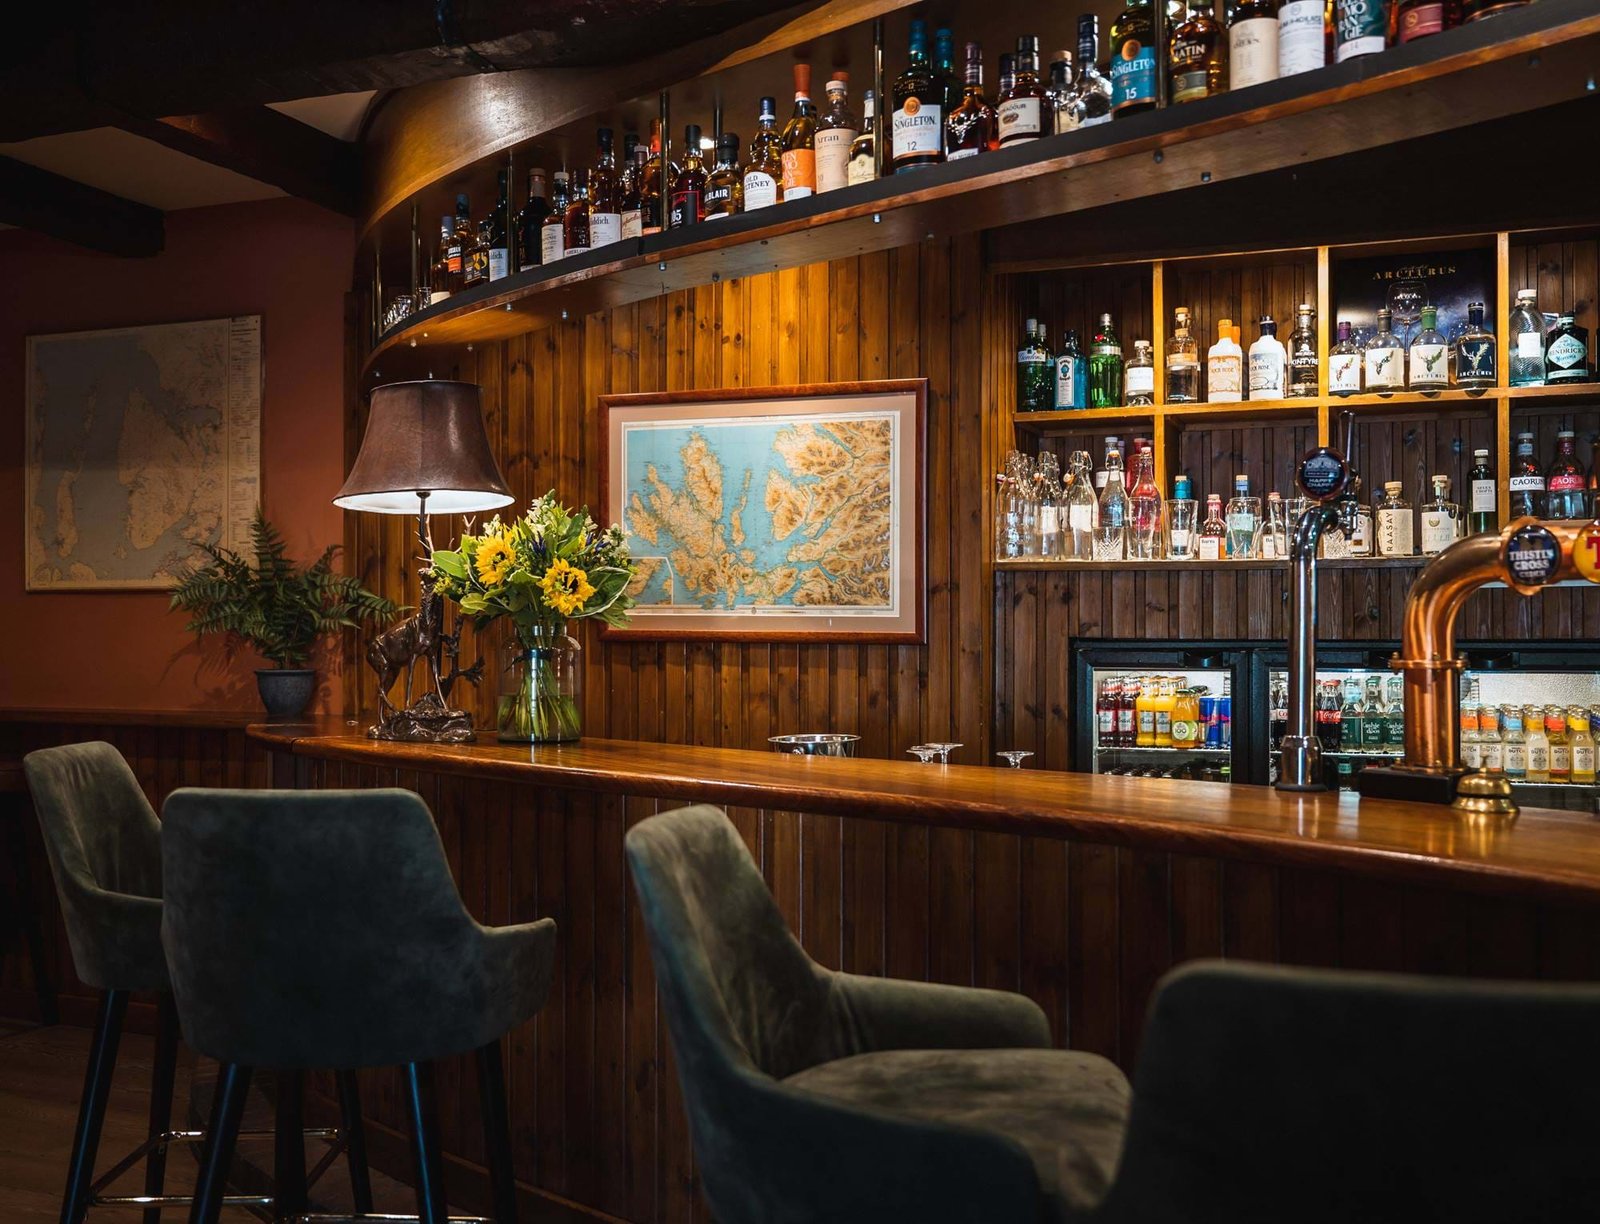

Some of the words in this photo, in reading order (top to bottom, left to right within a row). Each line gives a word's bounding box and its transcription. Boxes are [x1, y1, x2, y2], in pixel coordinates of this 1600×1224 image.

[1125, 88, 1137, 99] 15
[894, 115, 936, 131] SINGLETON
[907, 141, 918, 151] 12
[1373, 266, 1456, 279] ARCTURUS
[1508, 549, 1555, 561] THISTLY
[1514, 560, 1550, 570] CROSS
